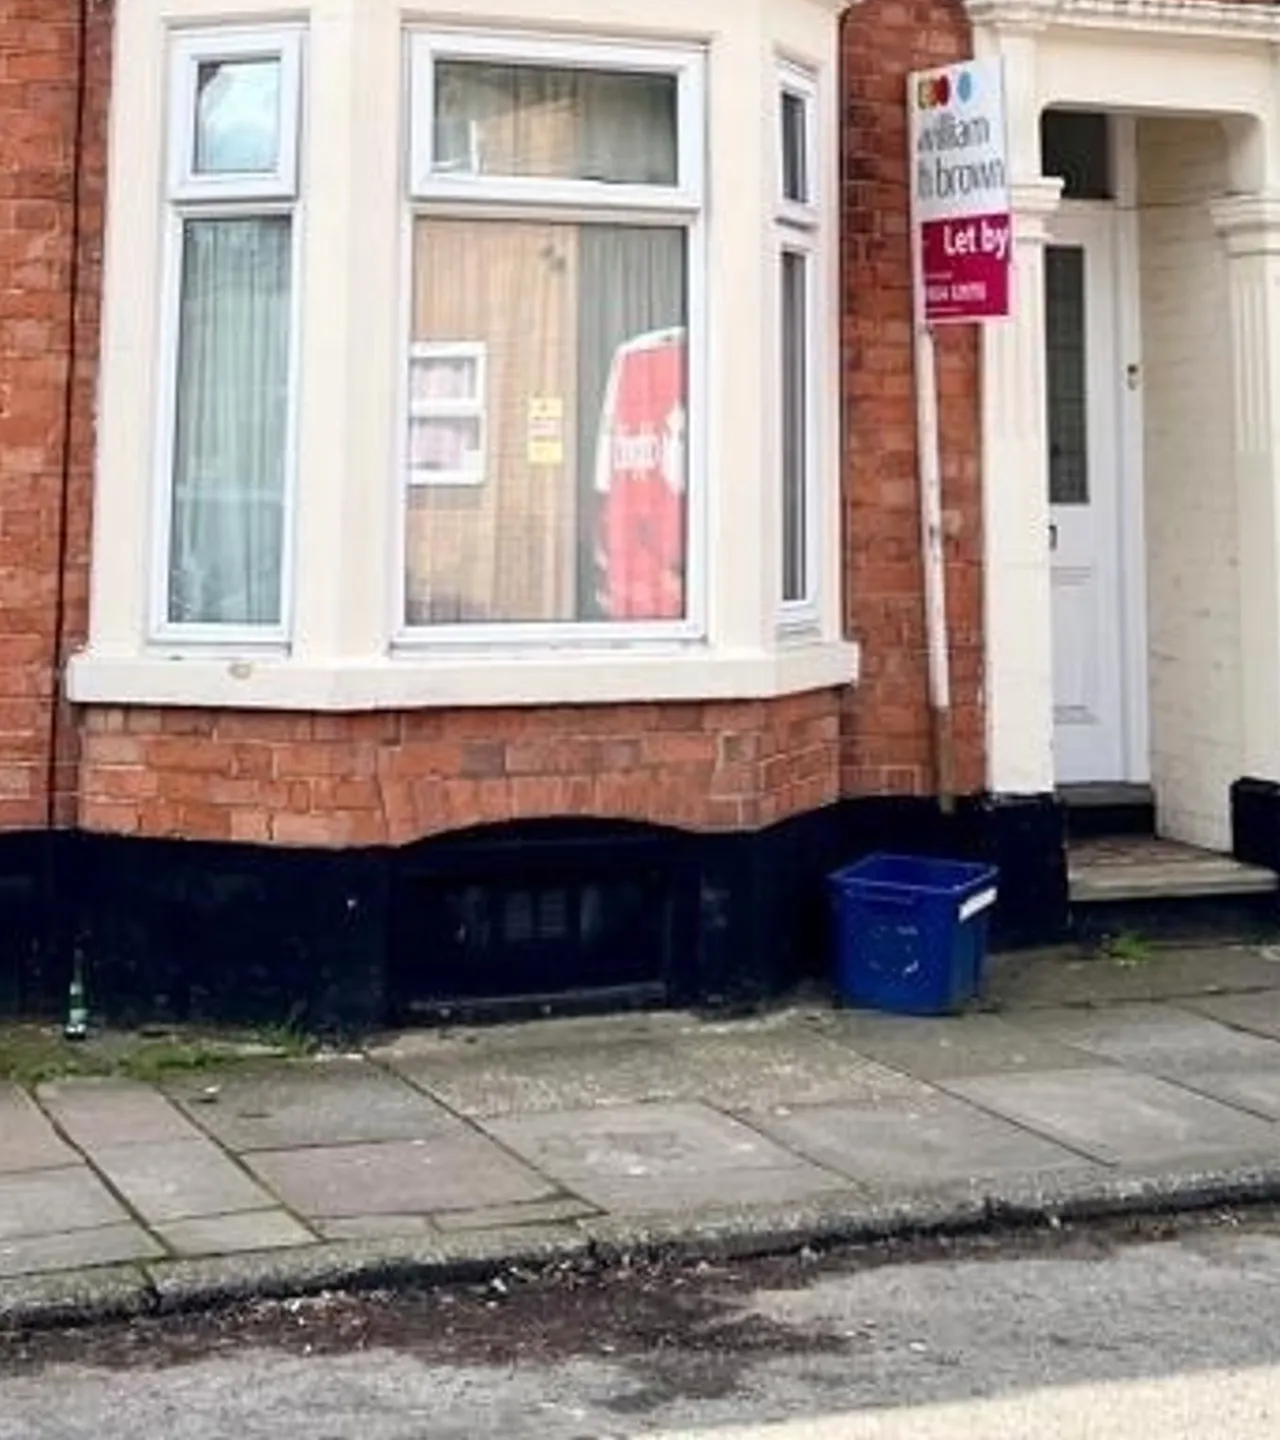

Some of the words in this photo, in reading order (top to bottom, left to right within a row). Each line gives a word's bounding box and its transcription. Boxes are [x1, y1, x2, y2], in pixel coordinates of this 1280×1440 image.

[936, 157, 1005, 198] brown
[943, 224, 977, 257] Let
[980, 218, 1009, 260] by
